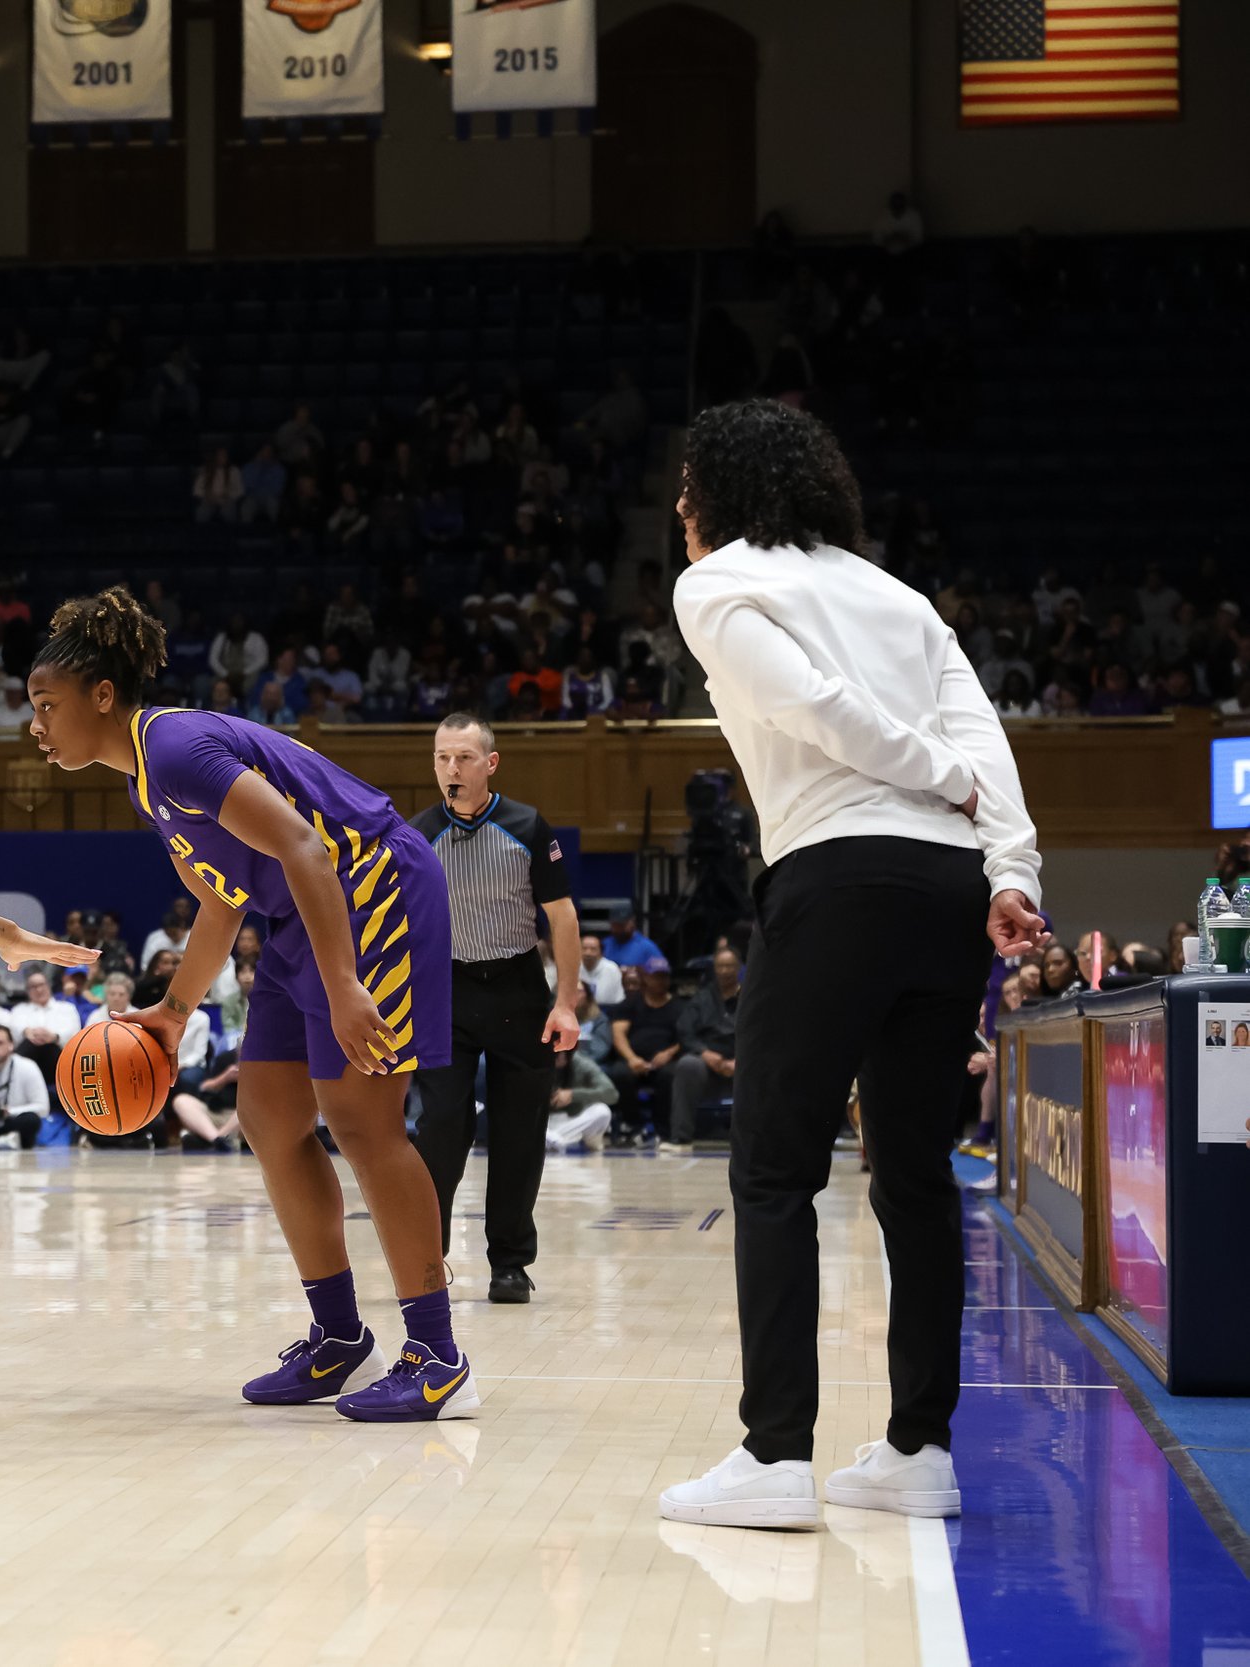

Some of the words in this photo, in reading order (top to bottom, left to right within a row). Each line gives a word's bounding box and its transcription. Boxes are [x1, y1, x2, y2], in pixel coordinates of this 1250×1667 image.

[283, 53, 347, 79] 2010
[494, 47, 559, 72] 2015
[73, 61, 132, 86] 2001
[79, 1054, 104, 1116] ELITE
[401, 1350, 422, 1365] LSU
